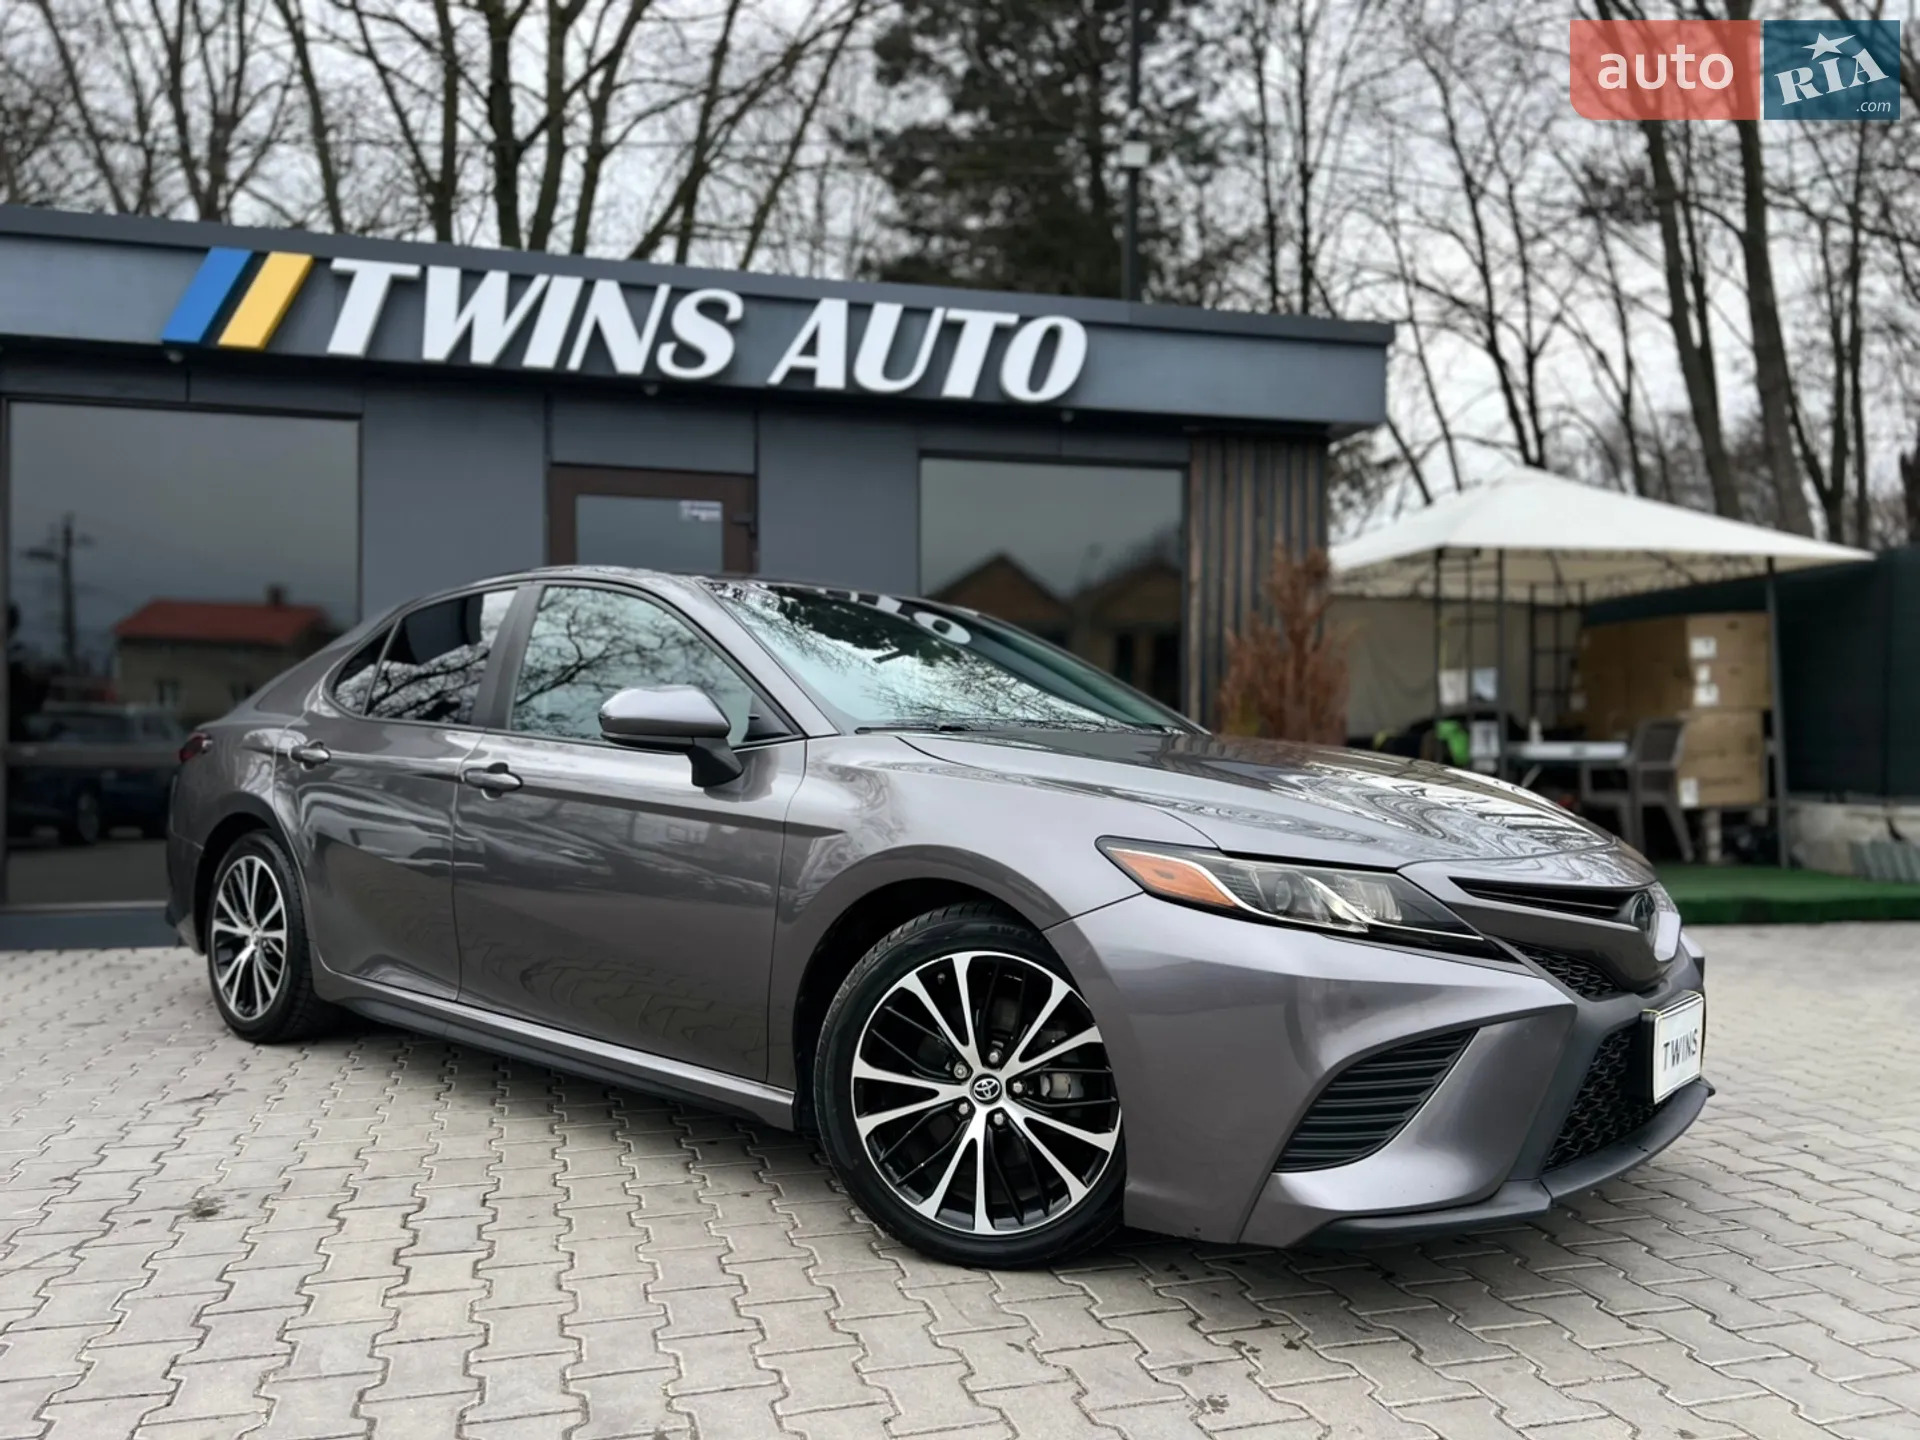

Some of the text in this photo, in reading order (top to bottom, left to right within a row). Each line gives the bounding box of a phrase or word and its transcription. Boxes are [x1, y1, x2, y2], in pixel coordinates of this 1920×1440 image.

[327, 257, 1088, 402] TWINS AUTO
[1663, 1028, 1698, 1071] TWINS
